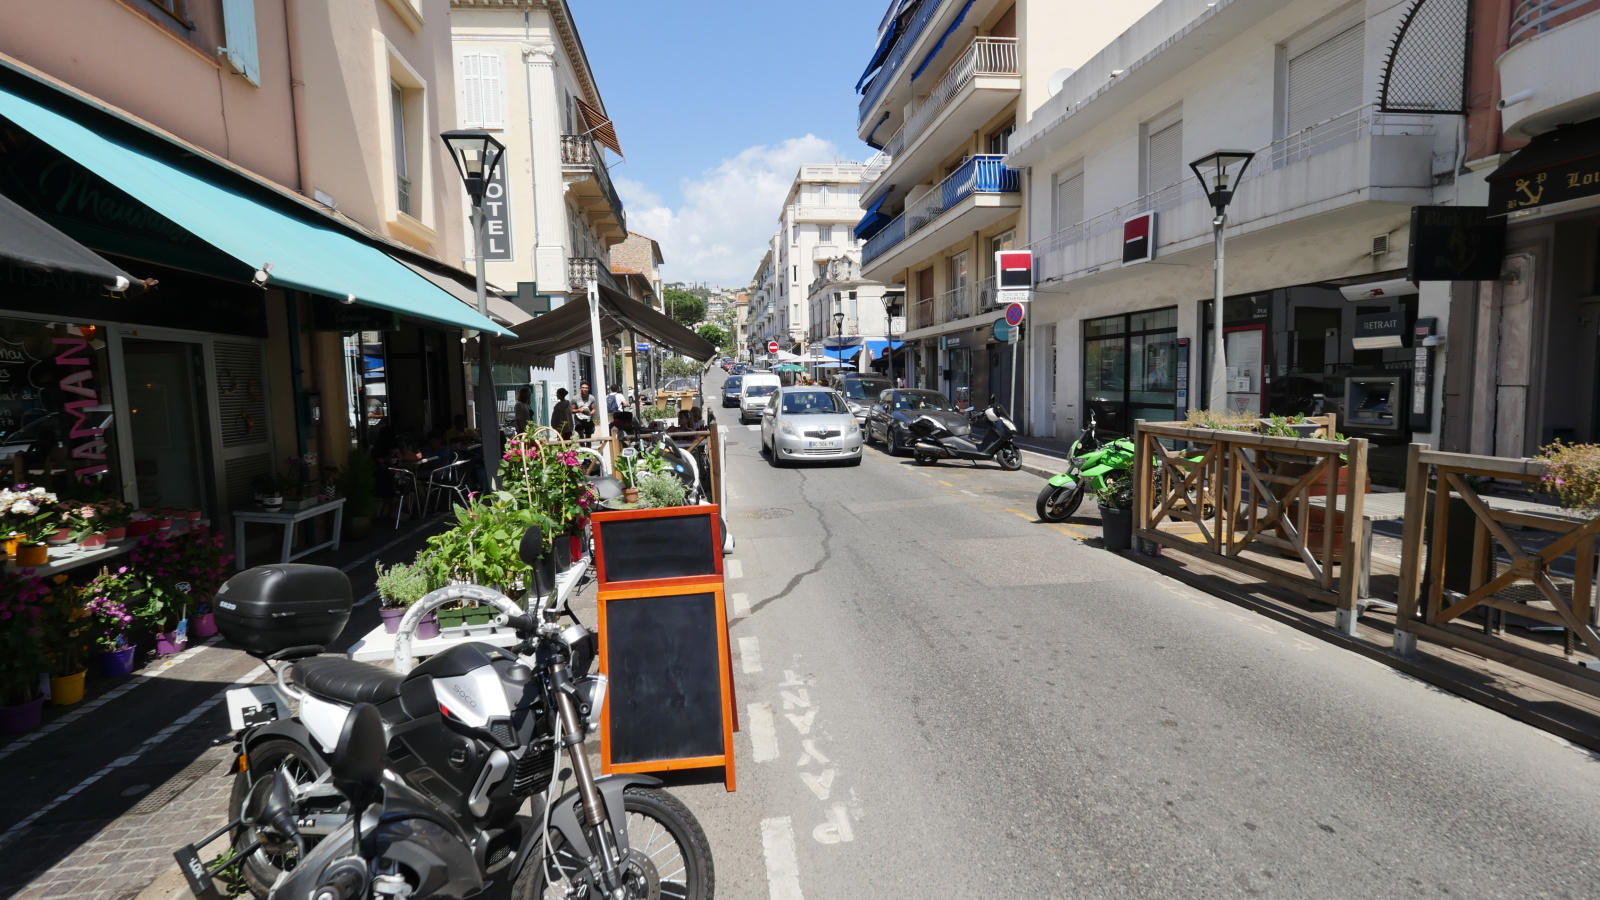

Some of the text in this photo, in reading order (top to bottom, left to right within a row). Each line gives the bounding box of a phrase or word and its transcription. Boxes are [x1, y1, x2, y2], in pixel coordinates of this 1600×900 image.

[483, 164, 505, 253] HOTEL
[1363, 319, 1398, 331] RETRAIT
[453, 684, 477, 708] SOCO
